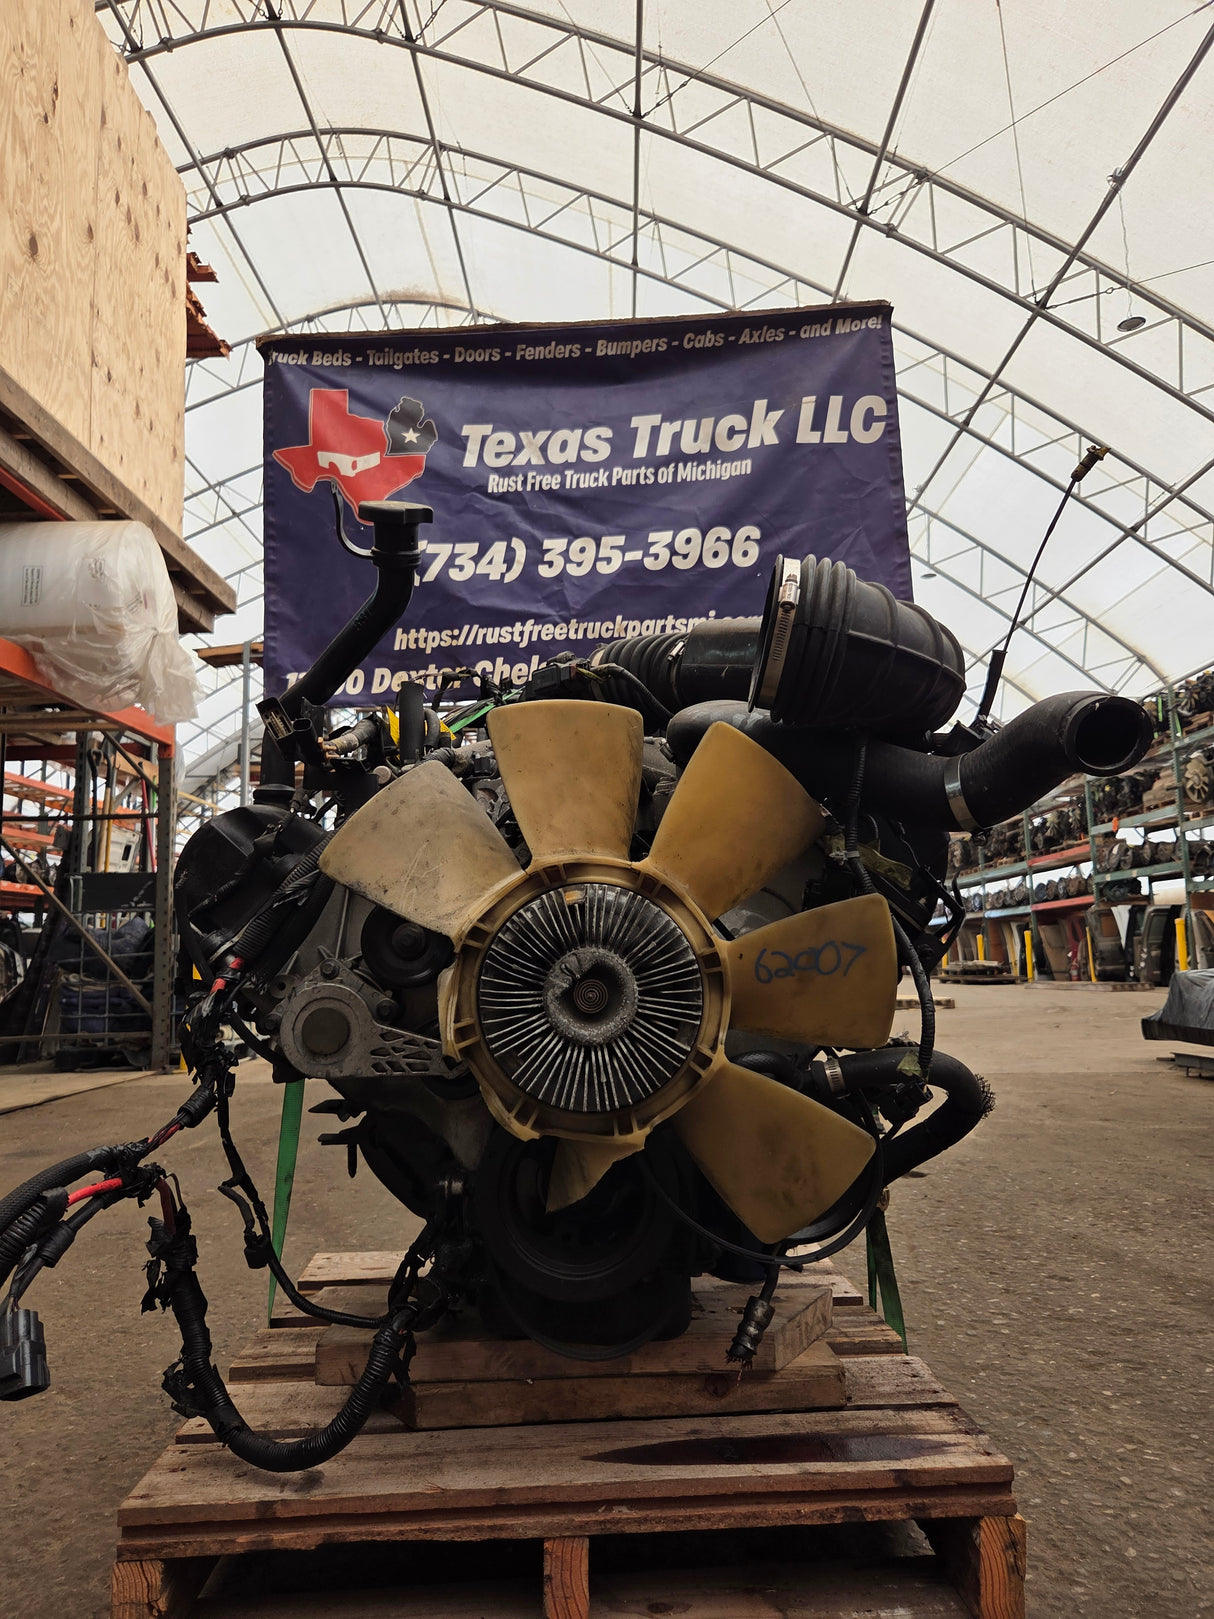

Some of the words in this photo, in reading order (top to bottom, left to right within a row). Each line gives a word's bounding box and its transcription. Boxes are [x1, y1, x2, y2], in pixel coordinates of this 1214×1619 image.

[312, 349, 351, 366] Beds
[367, 348, 439, 369] Tailgates
[454, 347, 500, 363] Doors
[516, 341, 581, 361] Fenders
[596, 337, 668, 359] Bumpers
[683, 330, 725, 350] Cabs
[738, 325, 785, 345] Axles
[800, 318, 833, 339] and
[835, 314, 883, 335] More!
[461, 424, 613, 468] Texas
[630, 398, 785, 459] Truck
[796, 395, 888, 444] LLC
[487, 472, 524, 494] Rust
[526, 471, 562, 492] Free
[564, 468, 608, 489] Truck
[611, 465, 655, 486] Parts
[657, 462, 677, 484] of
[677, 458, 753, 483] Michigan
[538, 526, 761, 578] 395-3966
[394, 610, 763, 654] https://rustfreetruckpartsm
[755, 940, 867, 984] 62007
